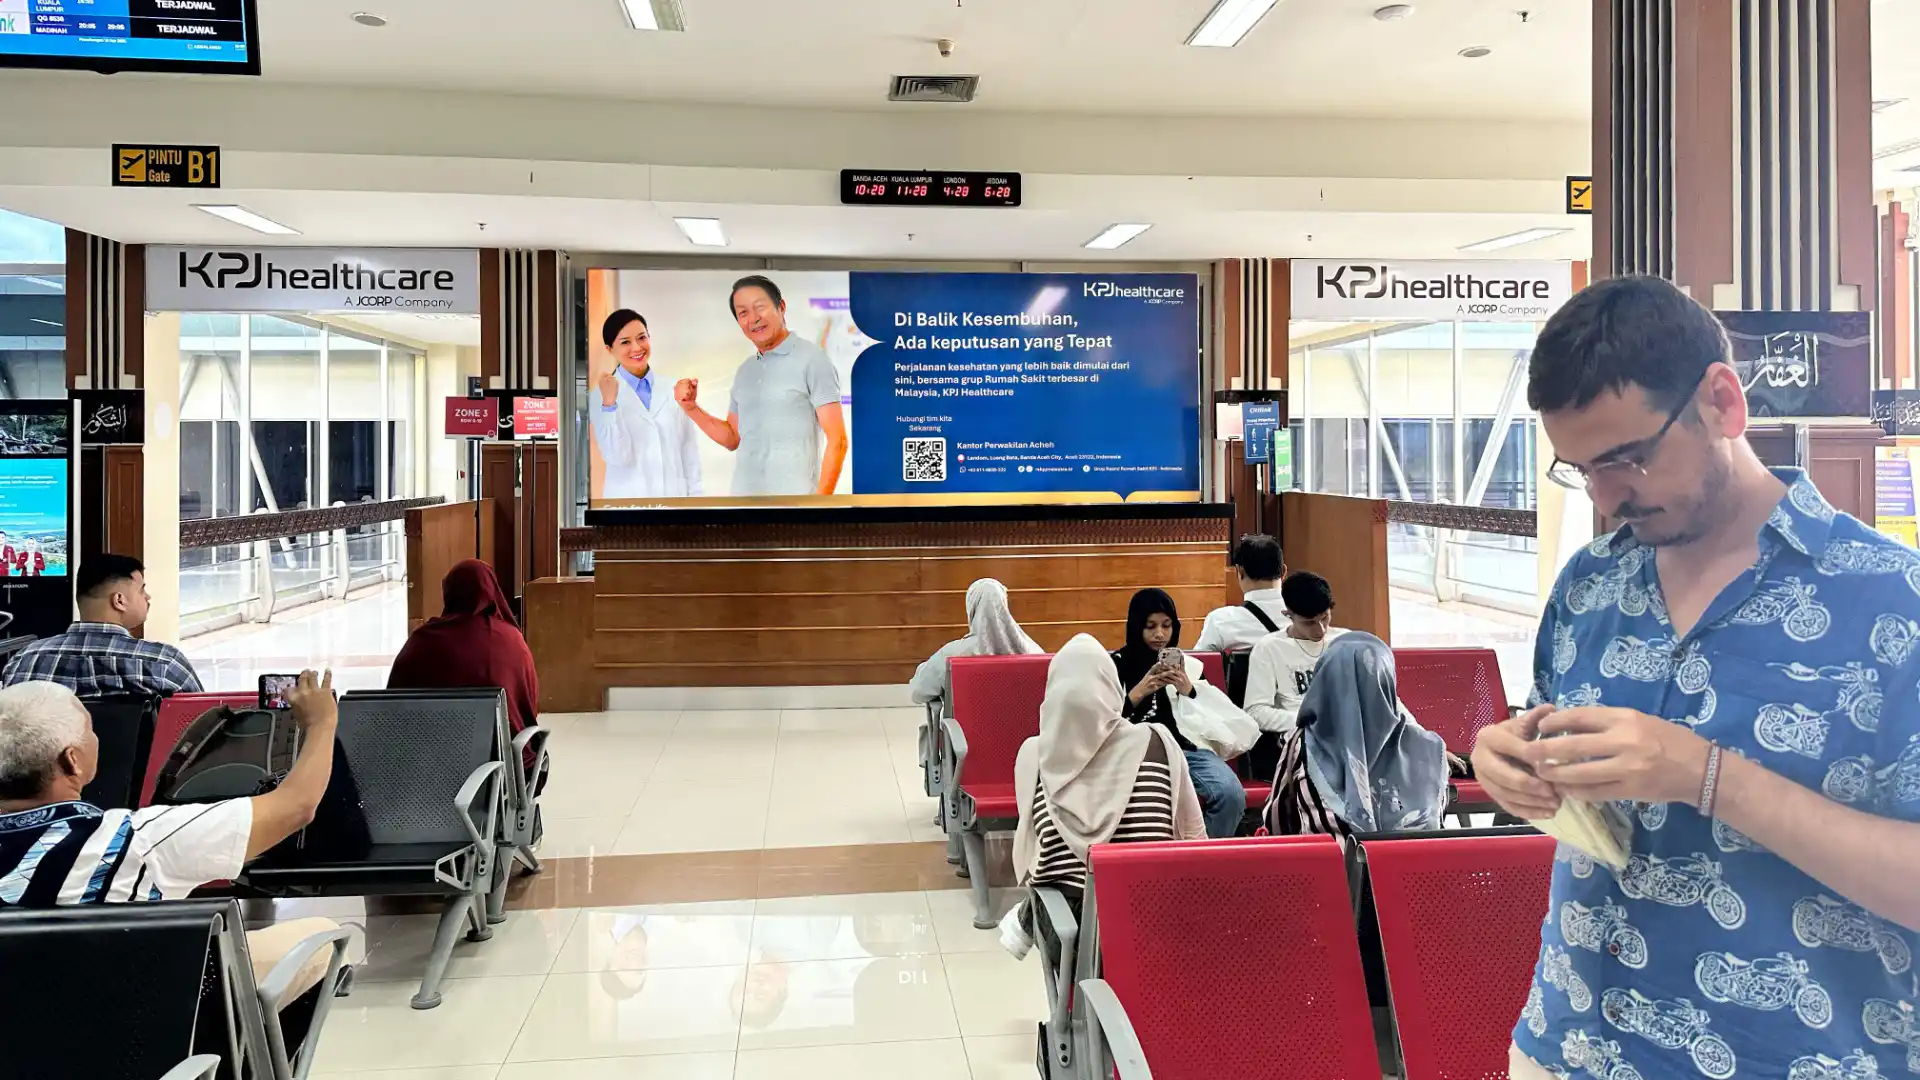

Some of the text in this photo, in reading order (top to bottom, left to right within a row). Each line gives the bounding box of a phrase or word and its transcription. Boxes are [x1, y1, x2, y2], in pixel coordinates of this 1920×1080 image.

[155, 0, 216, 10] TERJADWAL
[36, 26, 68, 34] MADINAH
[157, 24, 217, 35] TERJADWAL
[148, 149, 216, 184] PINTU B1
[148, 169, 171, 182] Gate
[855, 184, 885, 195] 10:28
[897, 185, 928, 196] 11:28
[943, 187, 969, 197] 4:28
[984, 187, 1011, 197] 6:28
[344, 296, 453, 309] A JCORP Company
[1457, 304, 1549, 315] A JCORP Company
[894, 311, 1079, 328] Di Balik Kesembuhan,
[894, 333, 1112, 352] Ada keputusan yang Tepat
[894, 361, 1129, 373] Perjalanan kesehatan yang lebih baik dimulai dari
[894, 373, 1099, 386] sini, bersama grup Rumah Sakit terbesar di
[895, 387, 1014, 398] Malaysia, KPJ Healthcare
[523, 401, 544, 409] ZONE
[455, 408, 488, 417] ZONE 3
[896, 415, 925, 423] Hubungi
[909, 425, 942, 433] Sekarang
[984, 441, 1028, 449] Perwakilan
